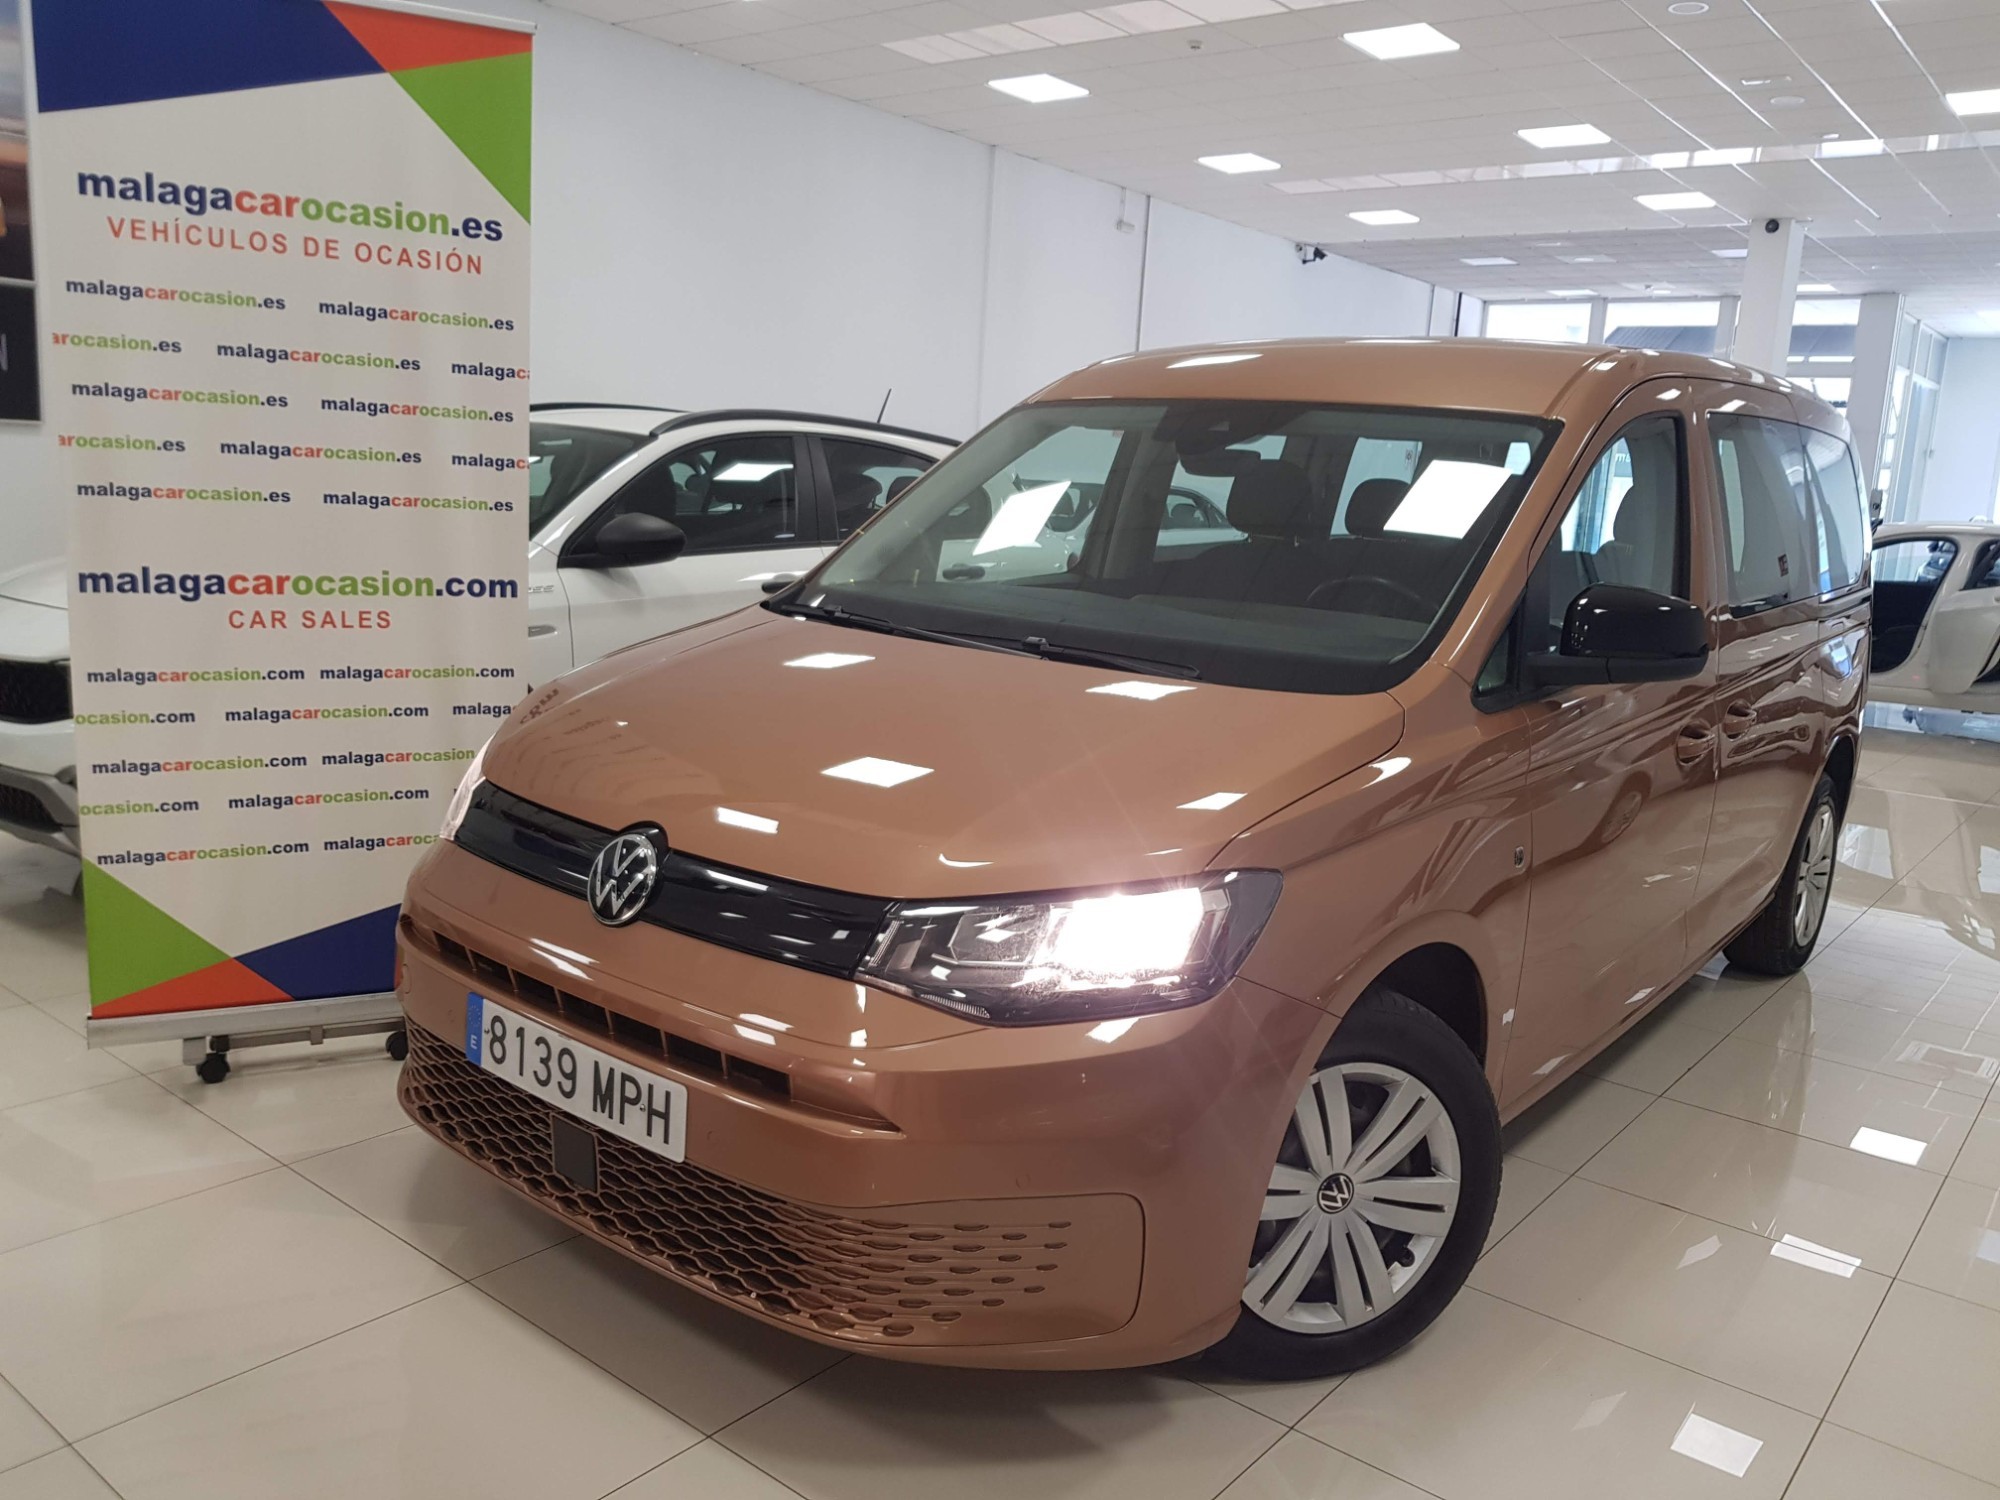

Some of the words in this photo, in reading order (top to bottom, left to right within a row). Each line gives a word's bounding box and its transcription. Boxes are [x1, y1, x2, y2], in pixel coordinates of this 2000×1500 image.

[77, 172, 503, 242] malagacarocasion.es
[107, 216, 289, 255] VEHÍCULOS
[304, 237, 340, 260] DE
[354, 242, 483, 276] OCASIÓN
[66, 280, 286, 311] malagacarocasion.es
[319, 301, 514, 332] malagacarocasion.es
[217, 343, 421, 372] malagacarocasion.es
[451, 362, 529, 381] malagac
[71, 381, 288, 408] malagacarocasion.es
[321, 397, 514, 423] malagacarocasion.es
[220, 441, 422, 464] malagacarocasion.es
[452, 453, 529, 471] malagac
[77, 482, 291, 504] malagacarocasion.es
[323, 491, 514, 513] malagacarocasion.es
[78, 566, 518, 602] malagacarocasion.com
[228, 609, 288, 630] CAR
[302, 609, 392, 630] SALES
[87, 667, 305, 684] malagacarocasion.com
[320, 664, 515, 681] malagacarocasion.com
[225, 704, 429, 722] malagacarocasion.com
[452, 702, 516, 718] malaga
[92, 755, 307, 775] malagacarocasion.com
[229, 788, 429, 809] malagacarocasion.com
[97, 841, 309, 866] malagacarocasion.com
[489, 1015, 577, 1099] 8139
[592, 1060, 672, 1145] MPH
